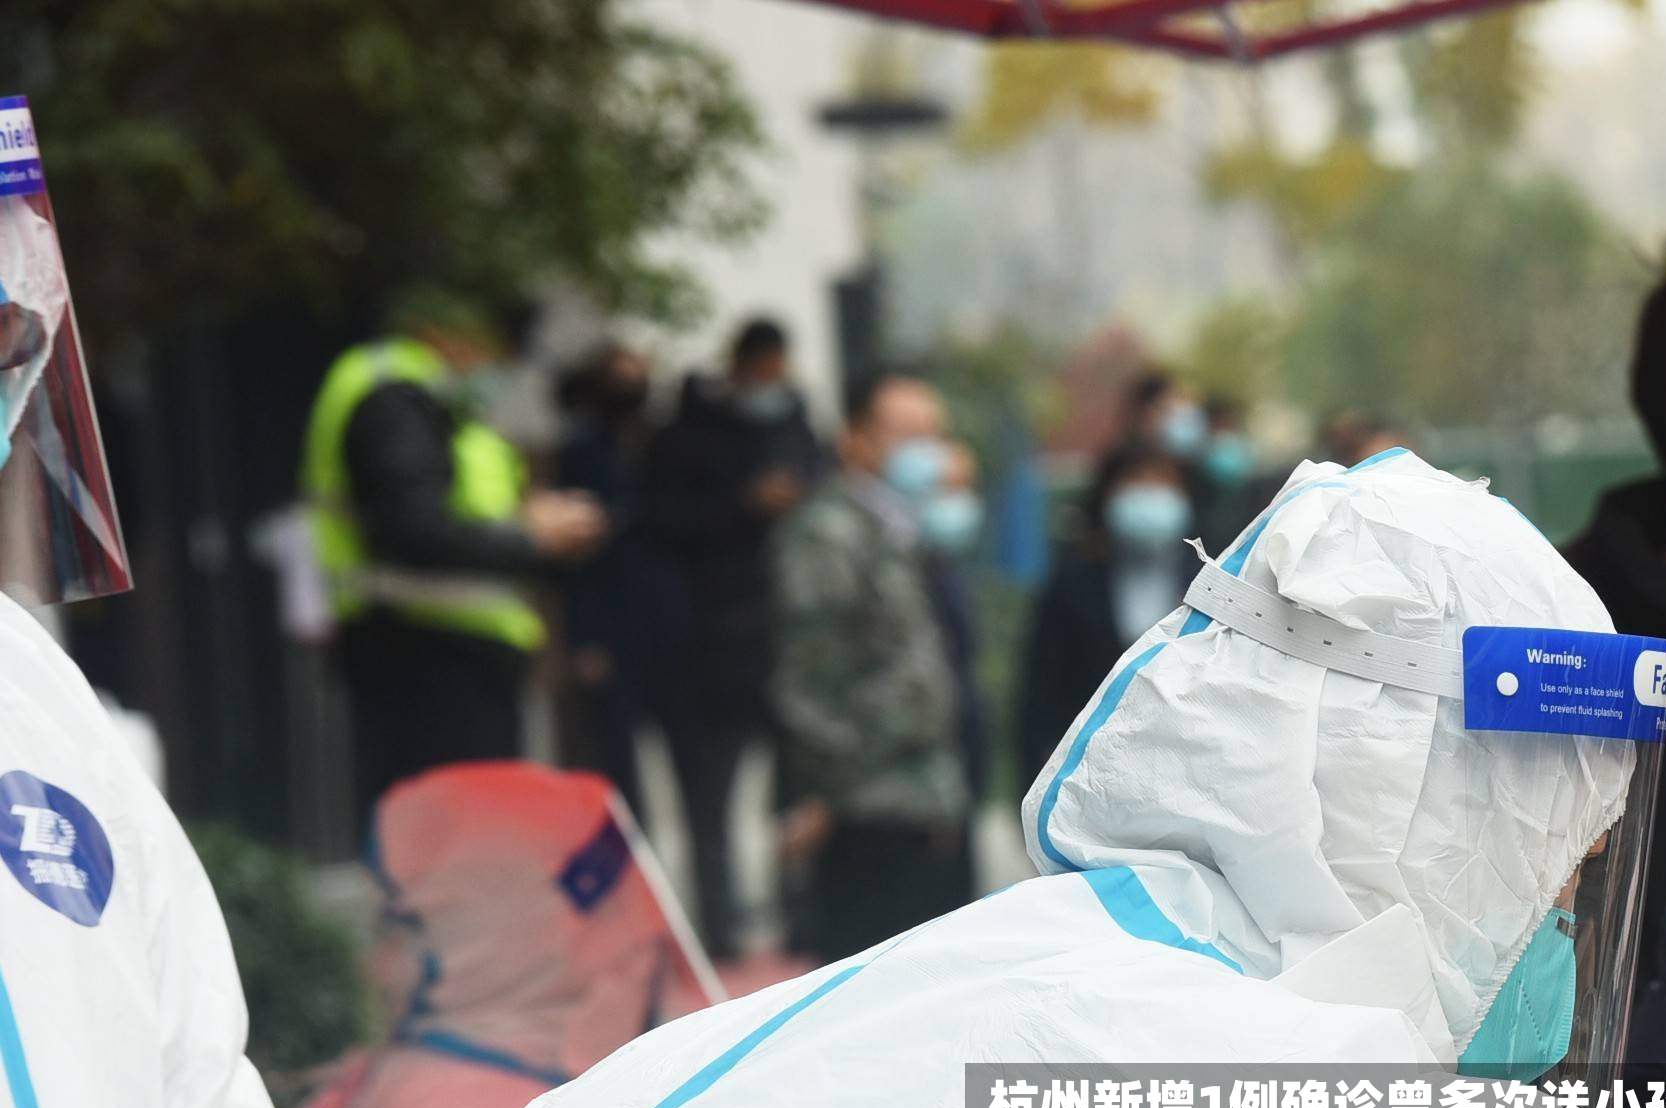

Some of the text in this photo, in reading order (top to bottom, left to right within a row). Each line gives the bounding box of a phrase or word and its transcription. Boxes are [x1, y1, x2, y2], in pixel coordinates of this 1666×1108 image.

[1526, 648, 1587, 670] Warning:
[1540, 682, 1624, 699] Use only as a face shield
[1540, 703, 1623, 720] to prevent fluid splashing
